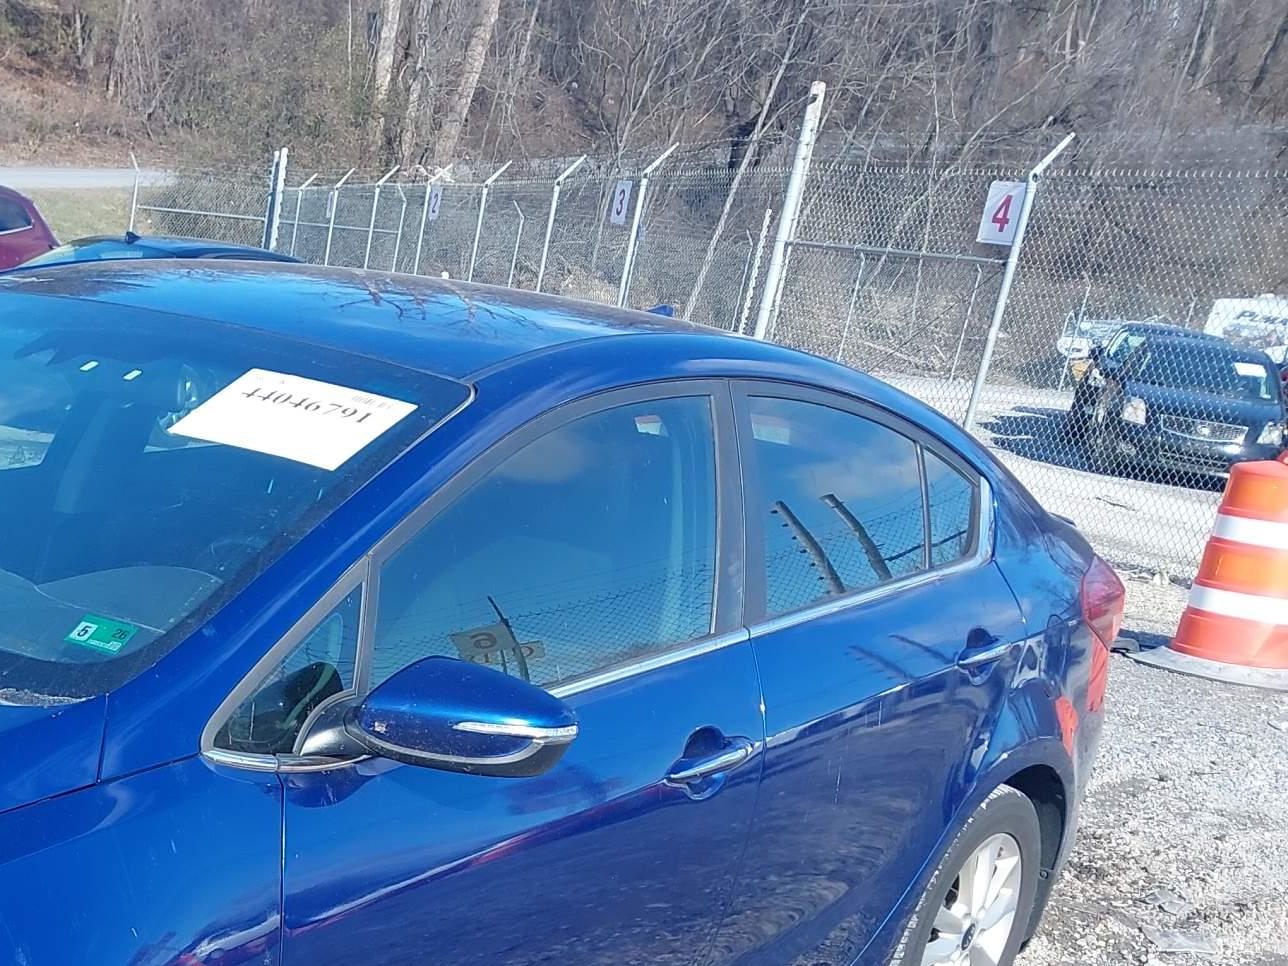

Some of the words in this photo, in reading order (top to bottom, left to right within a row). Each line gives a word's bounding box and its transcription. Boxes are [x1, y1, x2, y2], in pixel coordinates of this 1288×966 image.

[431, 193, 439, 214] 2
[615, 188, 626, 216] 3
[991, 194, 1013, 233] 4
[241, 387, 373, 423] 44046791
[76, 625, 92, 637] 5
[111, 628, 130, 640] 26
